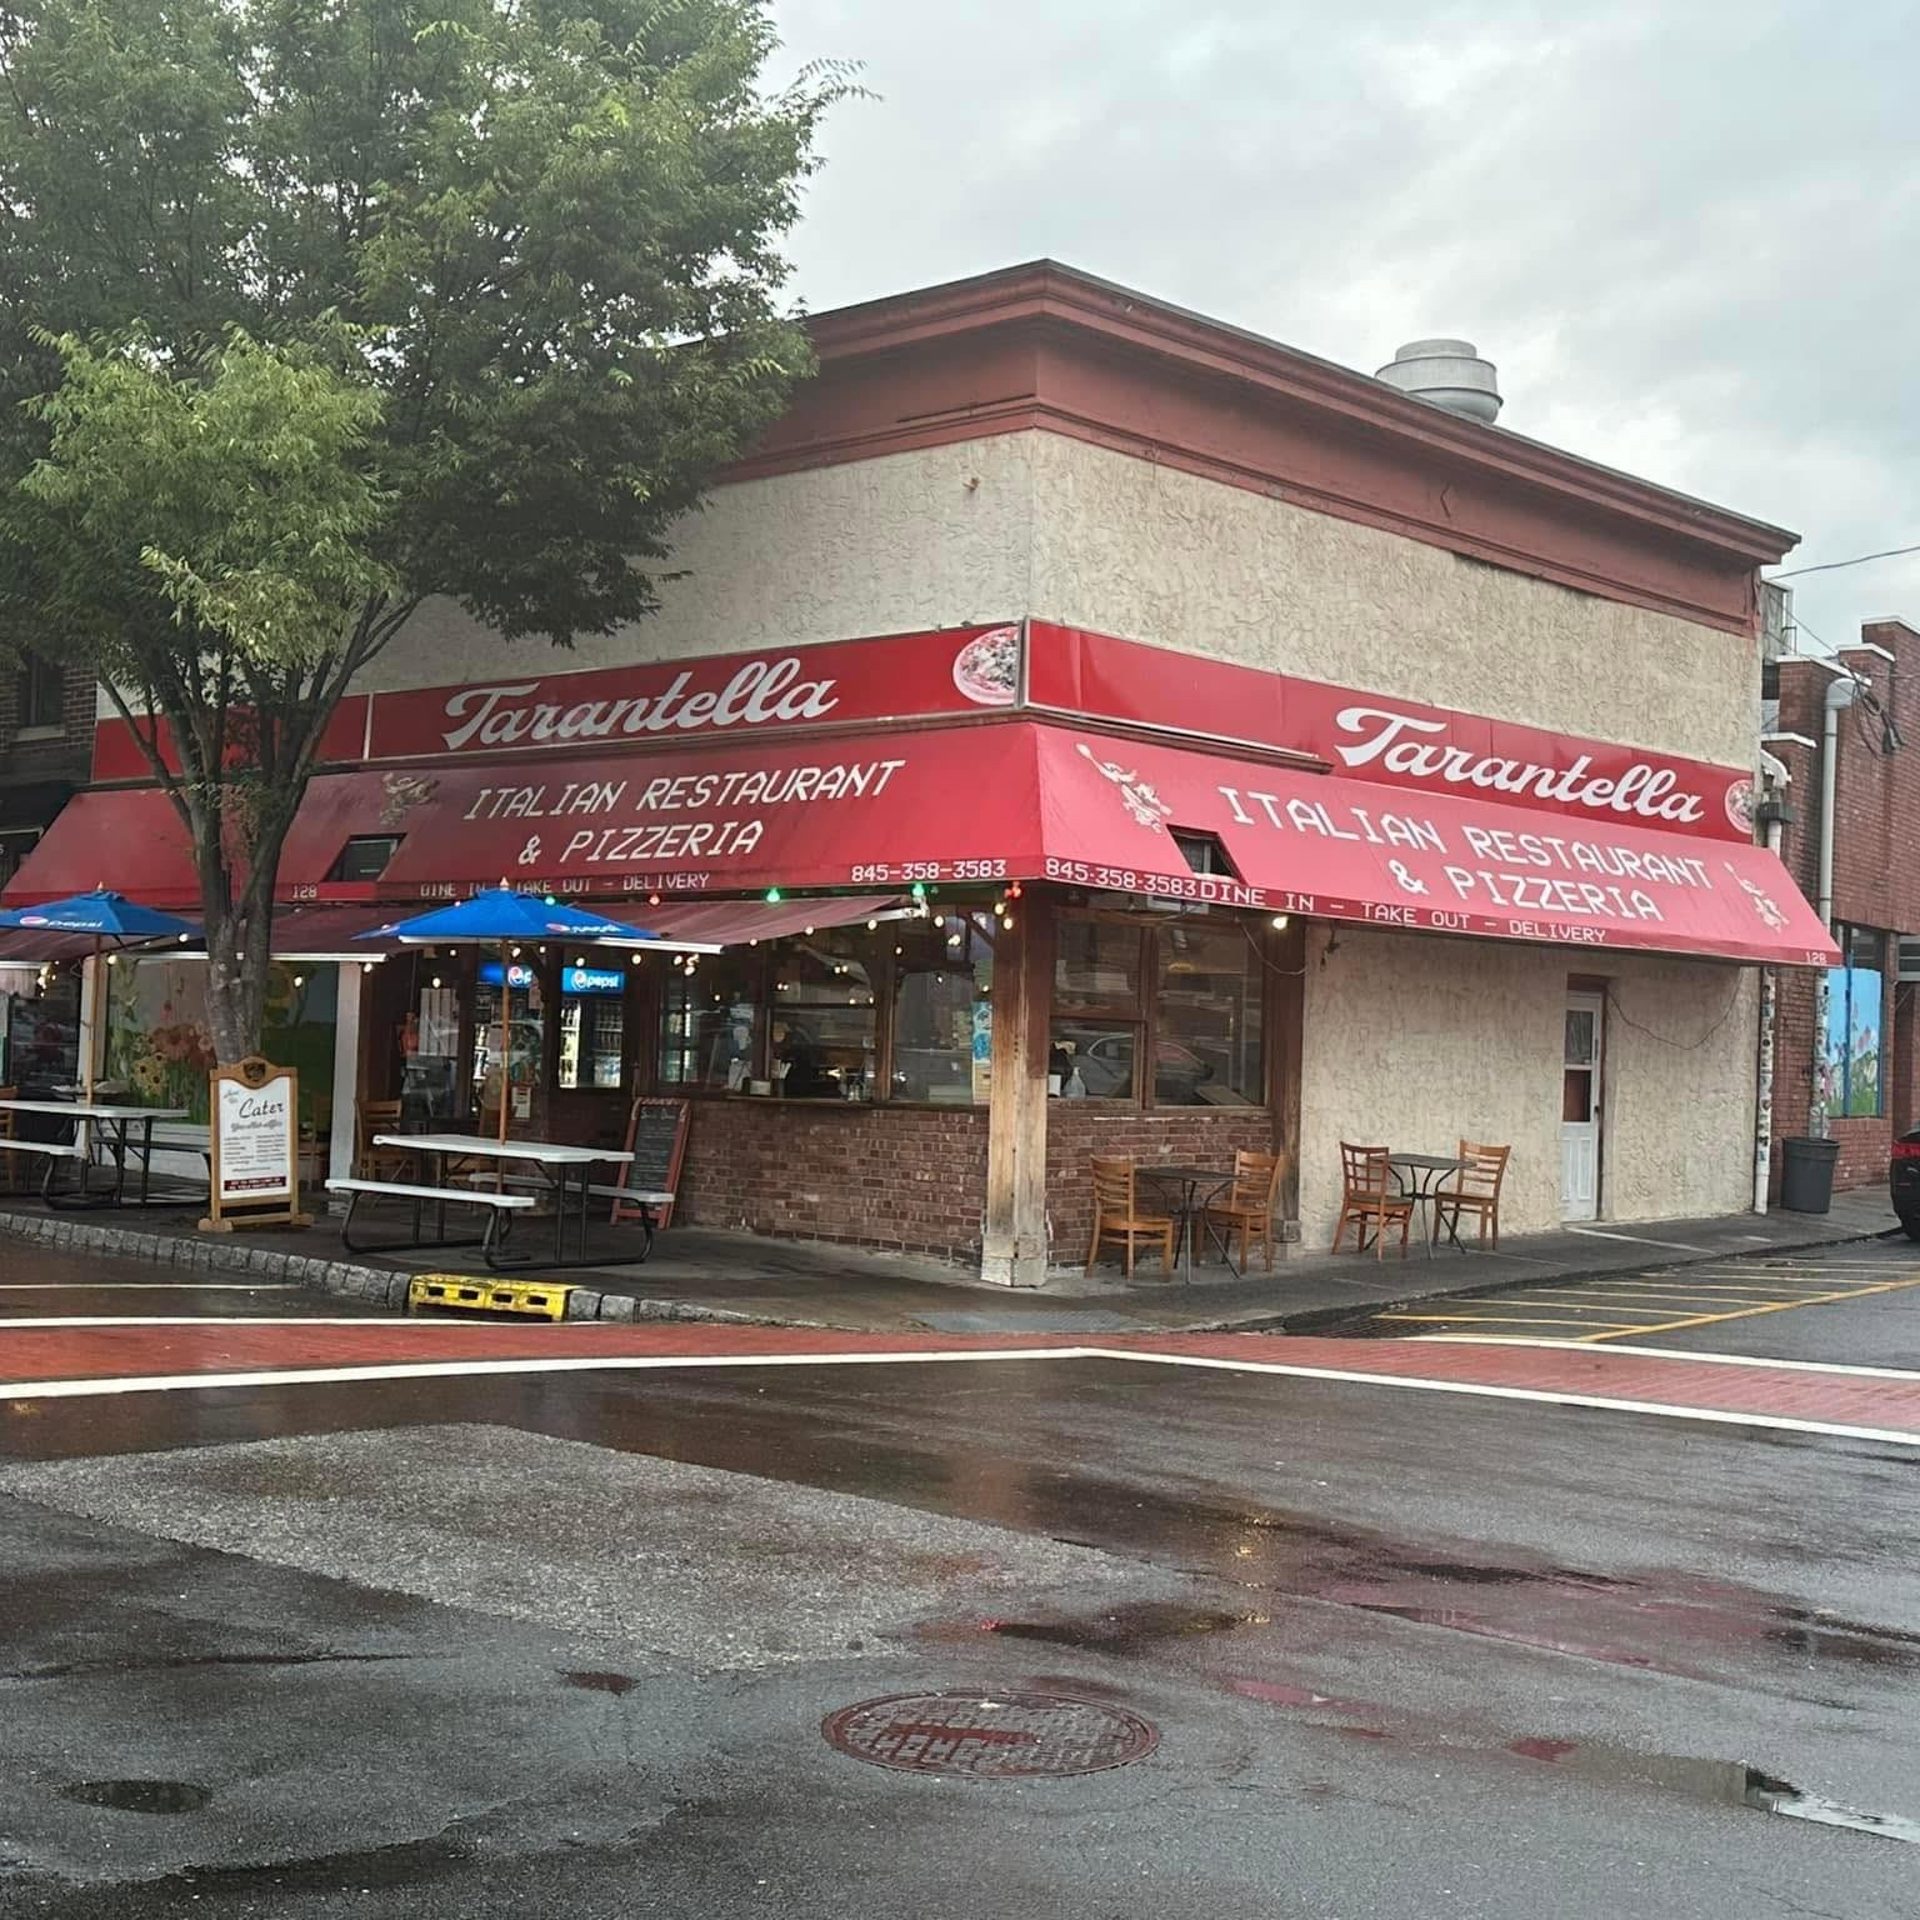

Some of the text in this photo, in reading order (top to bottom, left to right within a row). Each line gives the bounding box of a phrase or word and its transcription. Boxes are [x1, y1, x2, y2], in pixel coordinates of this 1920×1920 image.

[441, 657, 839, 751] Tarantella
[1334, 706, 1704, 823] Tarantella
[464, 760, 907, 820] ITALIAN RESTAURANT
[518, 820, 764, 865] & PIZZERIA
[1217, 786, 1714, 889] ITALIAN RESTAURANT
[292, 884, 318, 899] 128
[420, 883, 457, 897] DINE
[562, 877, 593, 893] OUT
[622, 872, 711, 890] DELIVERY
[851, 859, 1007, 882] 845-358-3583
[1045, 857, 1197, 897] 845-358-3583
[1389, 859, 1665, 922] & PIZZERIA
[1201, 881, 1267, 906] DINE
[1285, 893, 1315, 911] IN
[1361, 901, 1417, 924] TAKE
[1431, 910, 1471, 930] OUT
[1509, 919, 1607, 943] DELIVERY
[1806, 951, 1827, 966] 128
[239, 1097, 284, 1119] Cater
